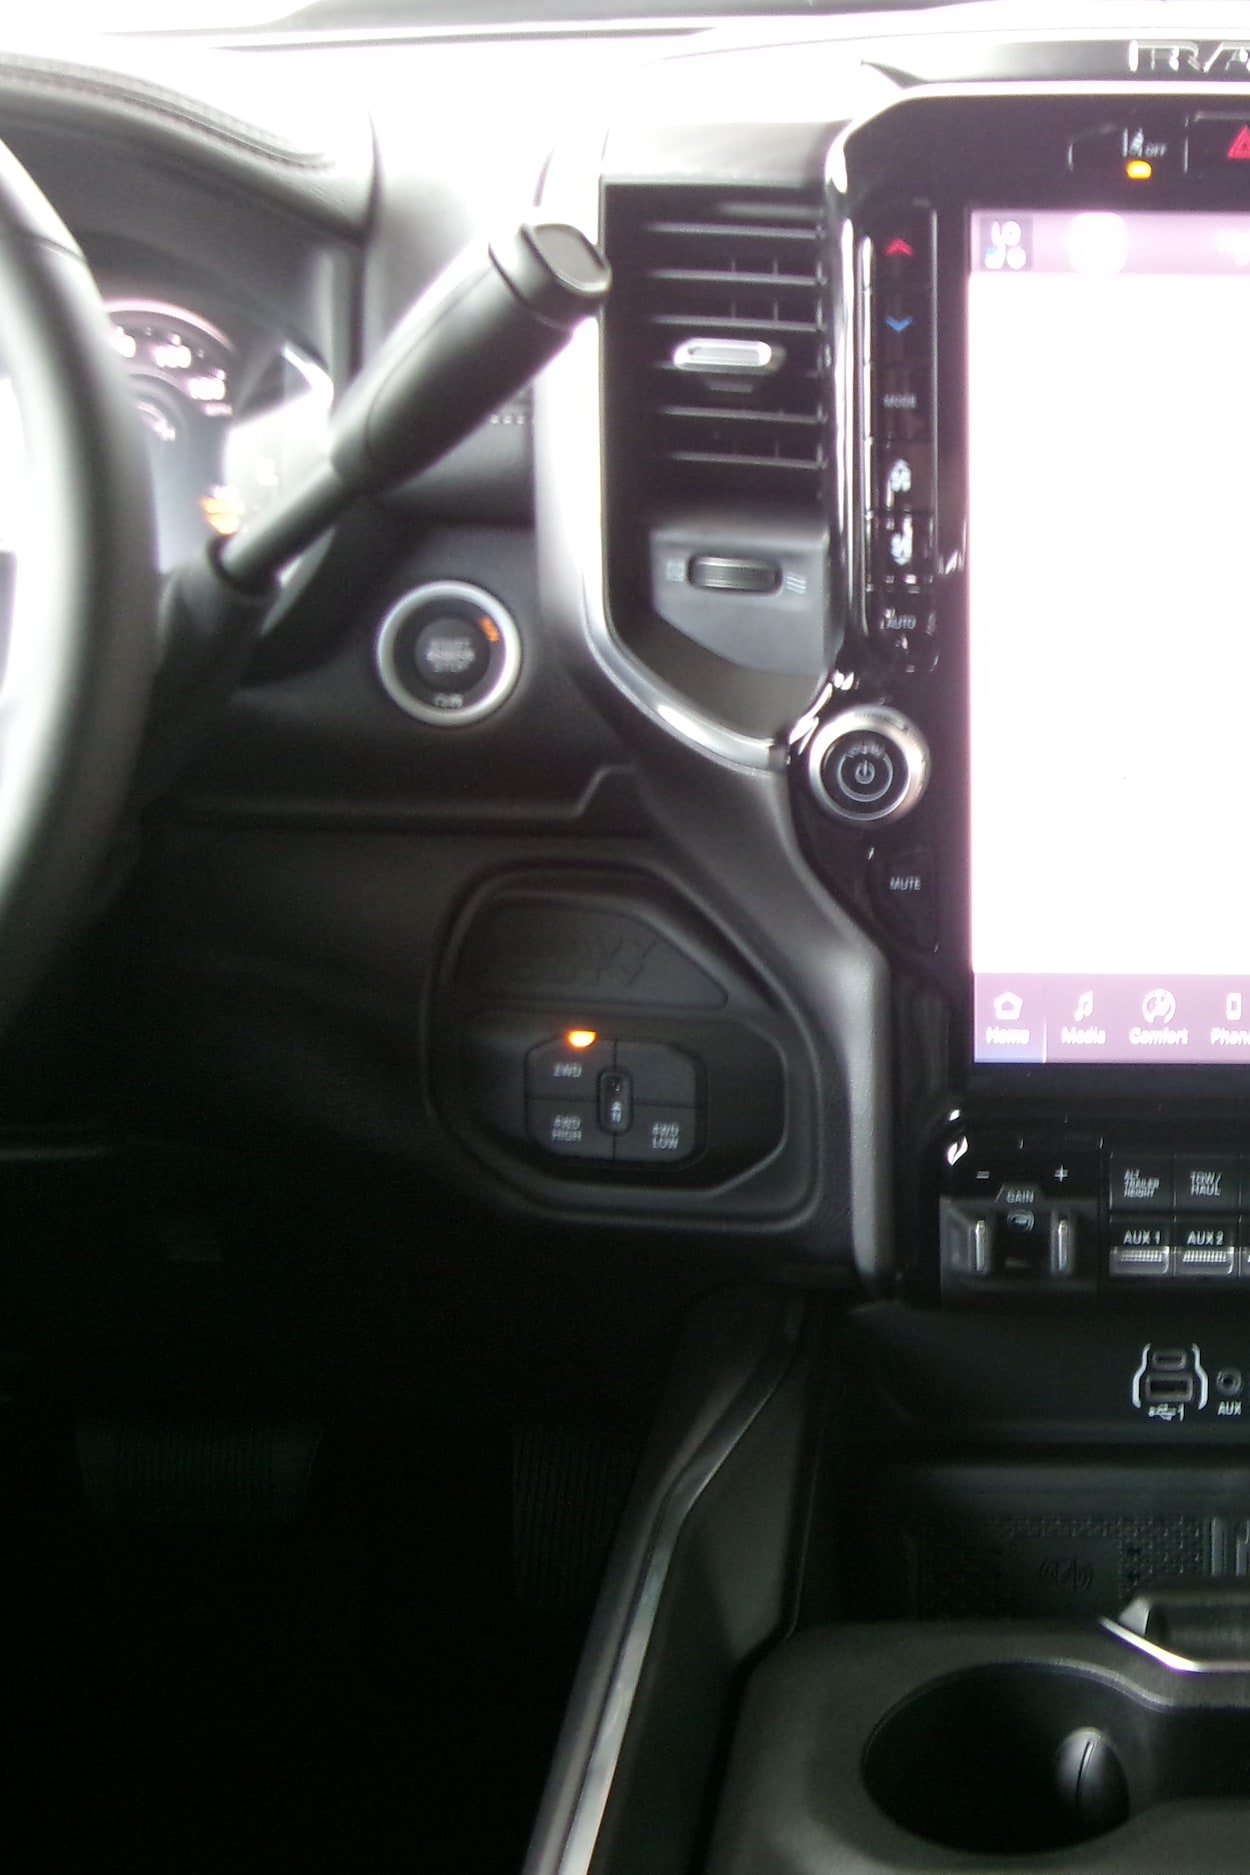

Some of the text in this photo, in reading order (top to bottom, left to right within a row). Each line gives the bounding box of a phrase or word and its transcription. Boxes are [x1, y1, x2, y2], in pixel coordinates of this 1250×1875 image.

[890, 876, 922, 891] MUTE
[985, 1026, 1030, 1046] Home
[1060, 1026, 1106, 1046] Media
[1128, 1026, 1189, 1046] Comfort
[1007, 1190, 1034, 1204] GAIN
[1190, 1184, 1220, 1196] HAUL
[1123, 1230, 1161, 1245] AUX 1
[1187, 1230, 1224, 1246] AUX 2
[1217, 1401, 1242, 1416] AUX
